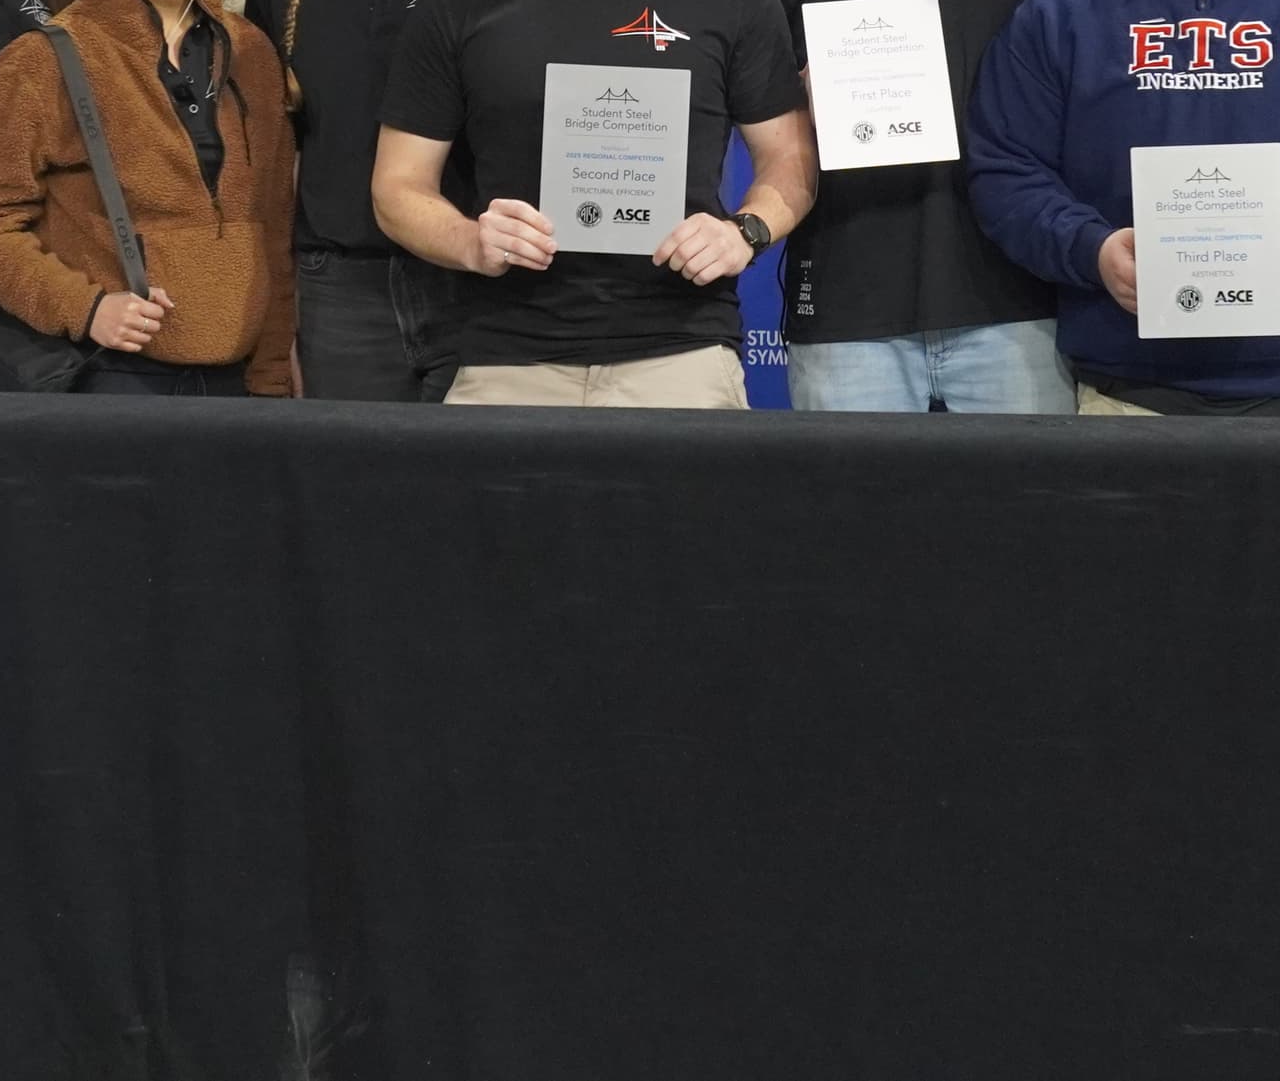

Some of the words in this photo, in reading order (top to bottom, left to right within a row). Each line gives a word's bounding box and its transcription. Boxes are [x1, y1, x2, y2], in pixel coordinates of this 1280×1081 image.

[841, 35, 880, 47] Student
[882, 32, 907, 43] Steel
[827, 47, 860, 59] Bridge
[863, 43, 925, 56] Competition
[1137, 71, 1264, 90] INGÉNIERIE
[851, 90, 876, 102] First
[880, 88, 912, 99] Place
[582, 107, 622, 119] Student
[626, 108, 652, 120] Steel
[564, 118, 600, 132] Bridge
[602, 119, 668, 133] Competition
[888, 121, 924, 135] ASCE
[572, 167, 619, 181] Second
[623, 169, 656, 182] Place
[1172, 188, 1215, 199] Student
[1218, 187, 1245, 198] Steel
[1155, 201, 1192, 214] Bridge
[1194, 199, 1263, 212] Competition
[613, 208, 651, 222] ASCE
[1175, 250, 1209, 263] Third
[1213, 250, 1248, 262] Place
[1215, 289, 1254, 303] ASCE
